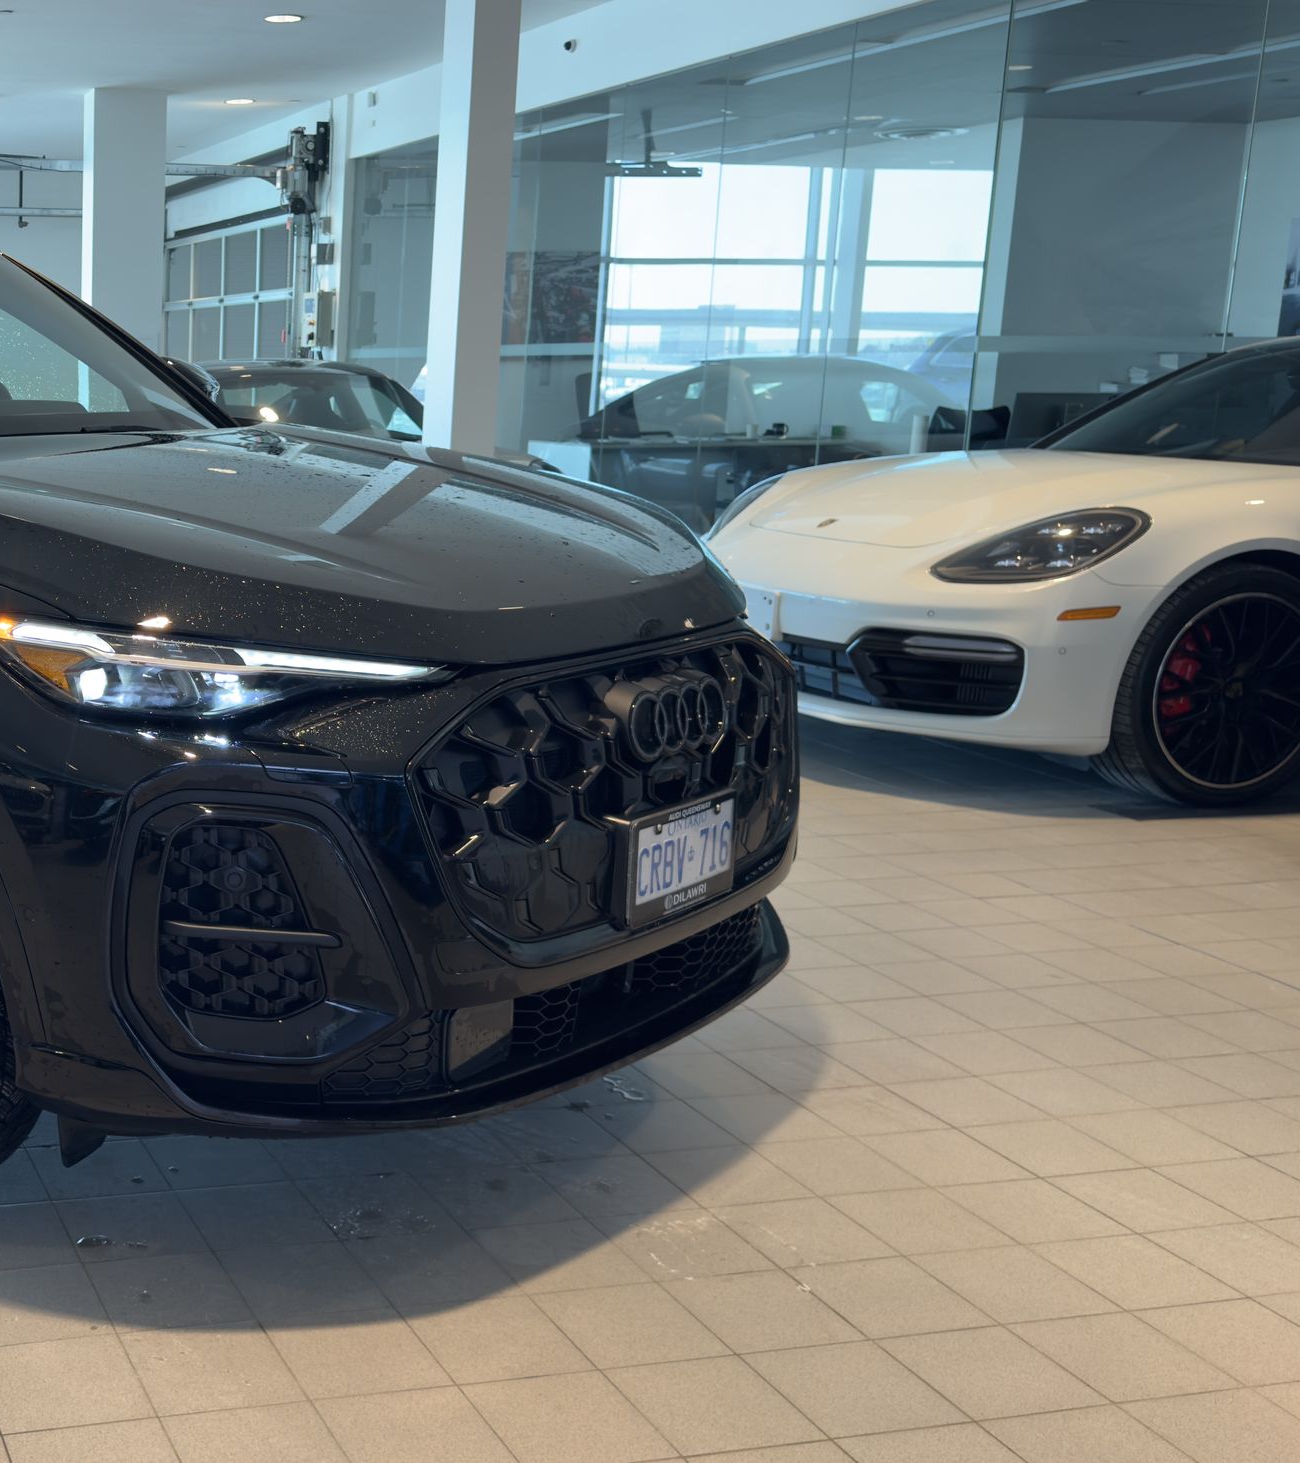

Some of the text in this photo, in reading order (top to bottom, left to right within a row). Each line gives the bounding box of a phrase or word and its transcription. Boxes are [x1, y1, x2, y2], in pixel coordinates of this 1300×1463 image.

[668, 809, 682, 822] AUDI
[638, 820, 731, 897] CRBV 716
[673, 882, 707, 905] DILAWRI
